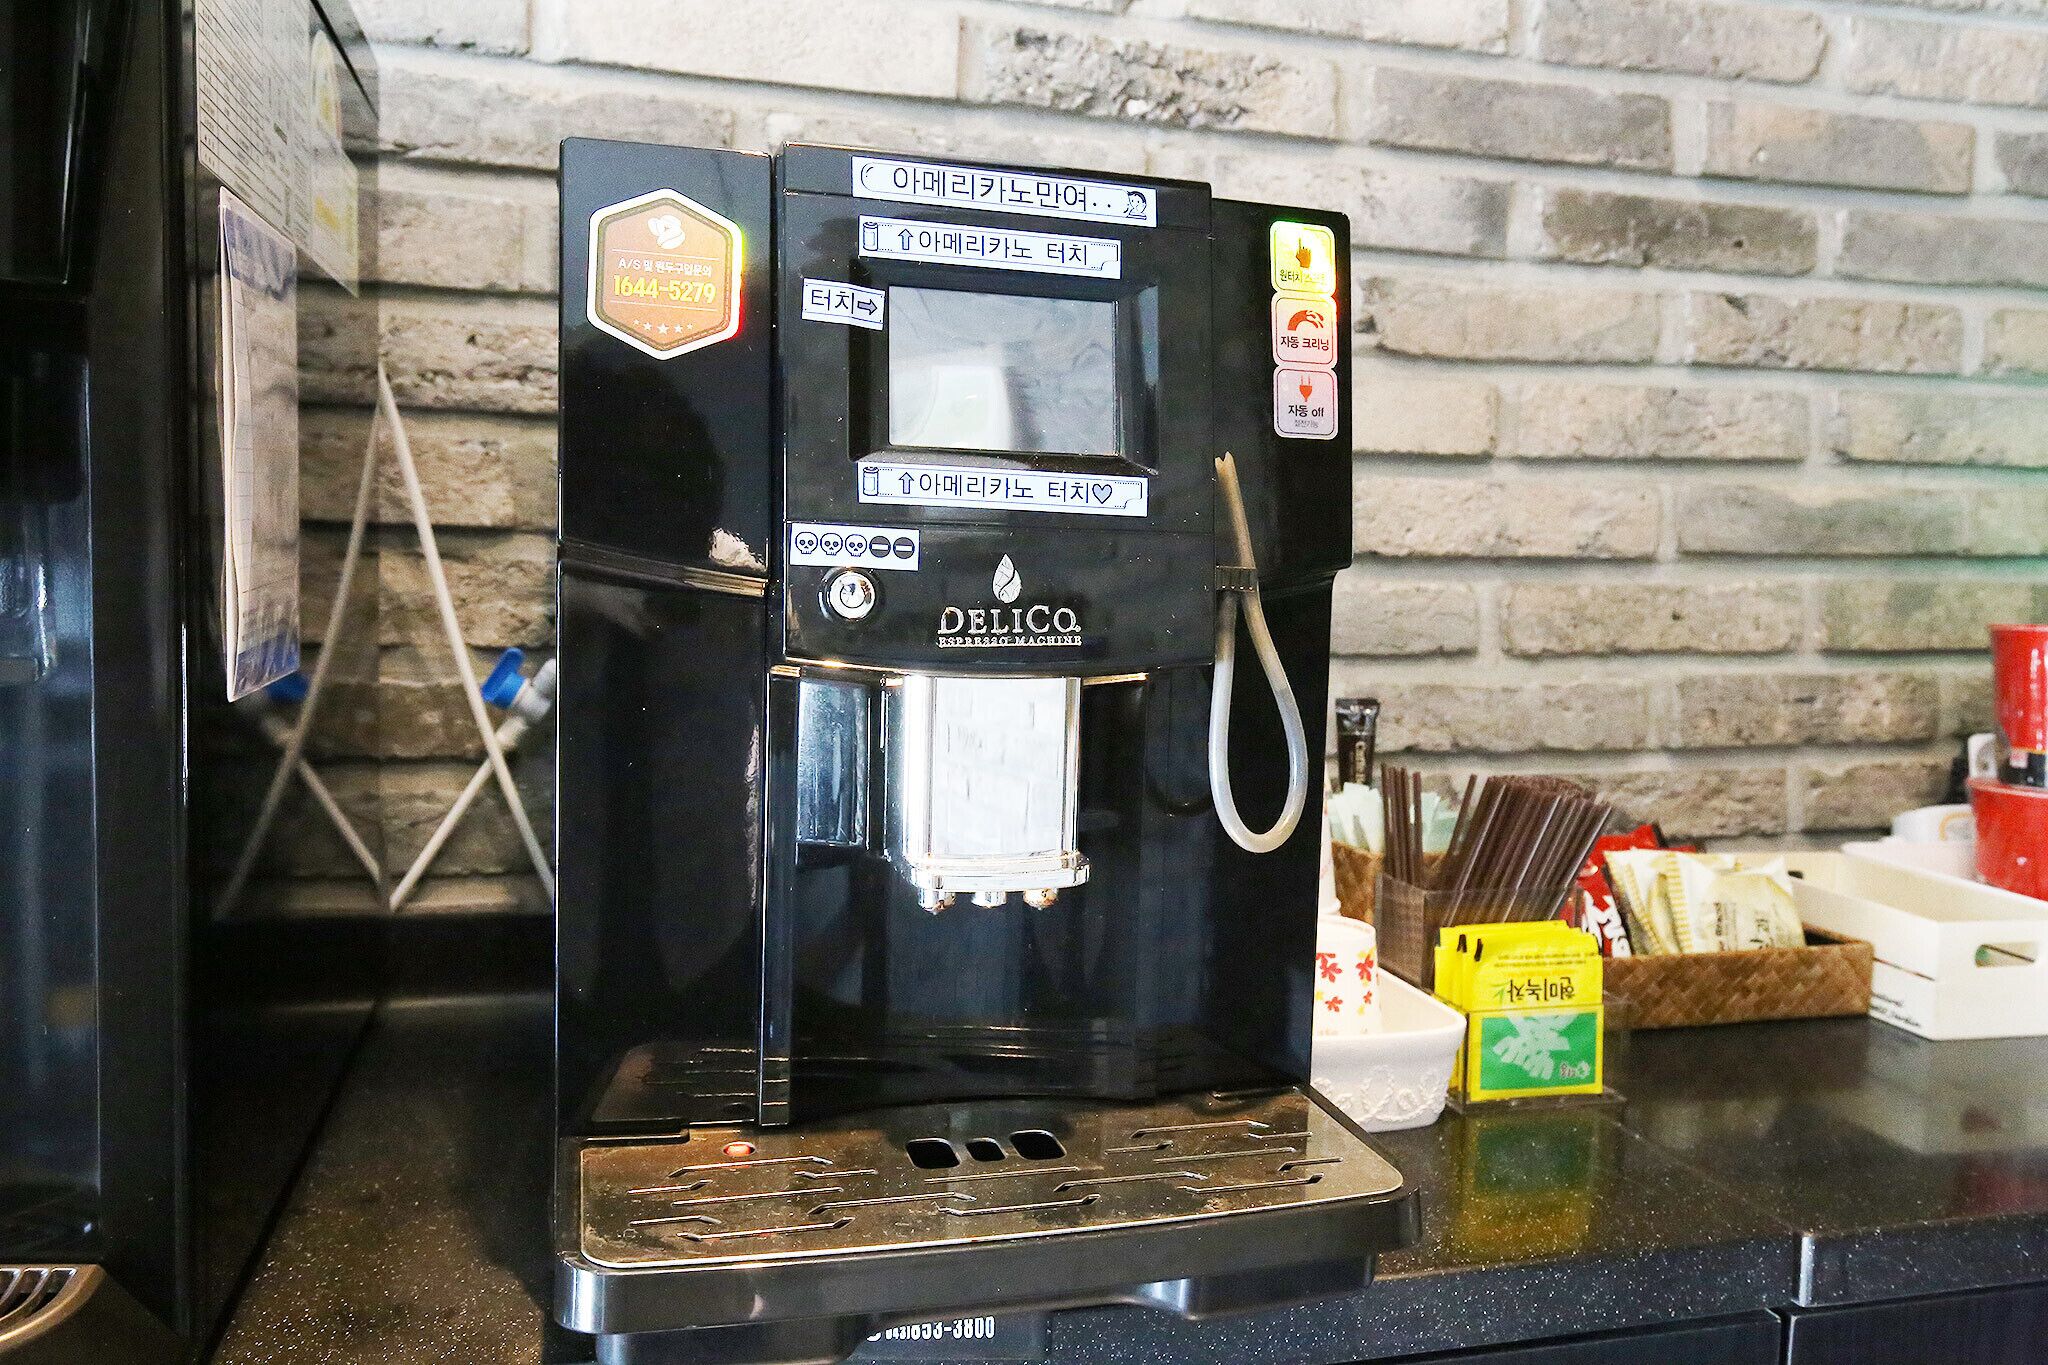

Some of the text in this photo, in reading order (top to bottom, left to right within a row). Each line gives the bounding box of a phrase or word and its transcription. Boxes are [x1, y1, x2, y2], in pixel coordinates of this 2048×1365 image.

[919, 230, 1088, 266] 아메리카노 터치
[618, 257, 641, 269] A/S
[613, 274, 717, 304] 1644-5279
[811, 288, 855, 315] 터치
[1280, 335, 1329, 351] 자동 크리닝
[1288, 404, 1324, 418] 자동 off
[919, 473, 1090, 504] 아메리카노 터치
[937, 635, 1082, 648] ESPRESSO MACHINE
[1507, 976, 1575, 1003] 현미녹차
